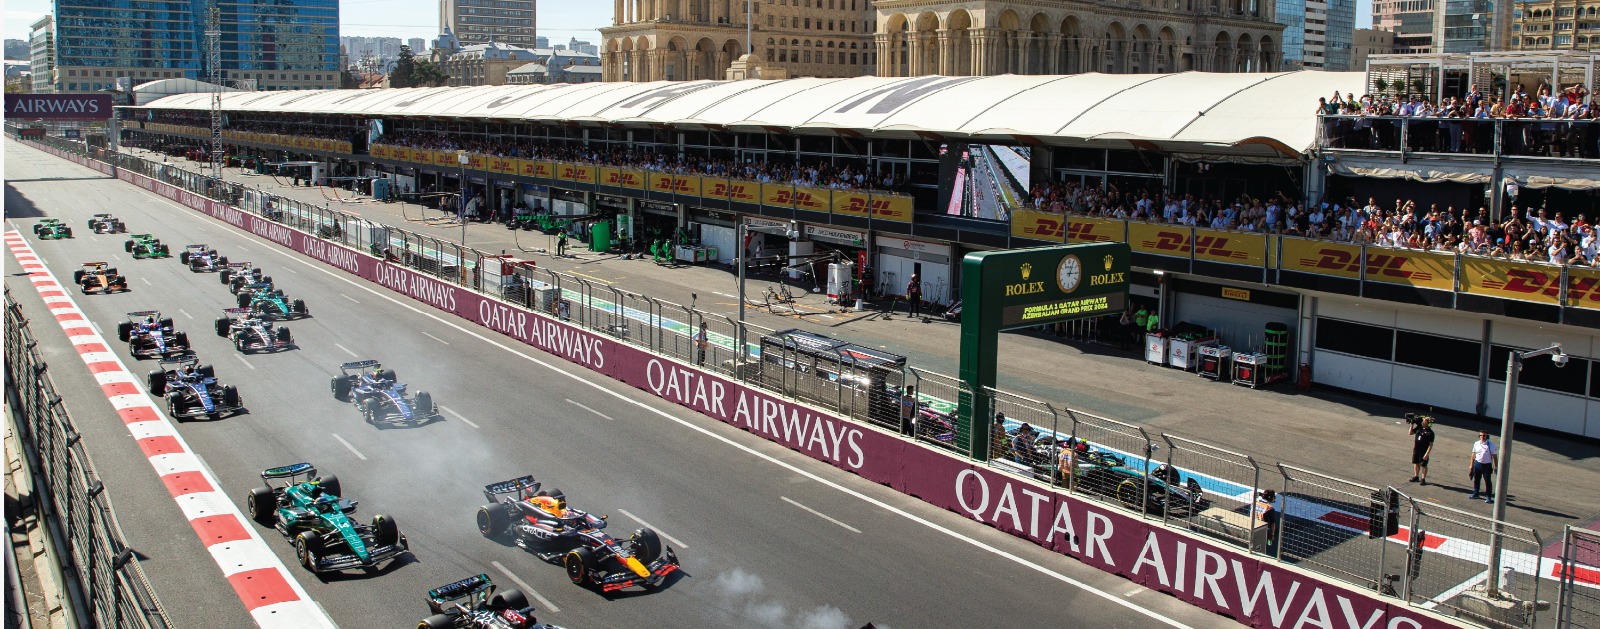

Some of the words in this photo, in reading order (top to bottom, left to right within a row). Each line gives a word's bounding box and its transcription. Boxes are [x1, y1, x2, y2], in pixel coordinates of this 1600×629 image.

[14, 99, 98, 112] AIRWAYS
[565, 168, 586, 178] DHL
[609, 173, 634, 184] DHL
[660, 178, 689, 191] DHL
[714, 184, 747, 199] DHL
[776, 190, 814, 207] DHL
[850, 197, 893, 215] DHL
[212, 203, 225, 220] QATAR
[225, 208, 243, 226] AIRWAYS
[251, 217, 268, 237] QATAR
[268, 223, 292, 246] AIRWAYS
[1035, 218, 1098, 240] DHL
[1155, 231, 1231, 257] DHL
[303, 236, 326, 260] QATAR
[327, 245, 359, 273] AIRWAYS
[1316, 249, 1413, 279] DHL
[376, 262, 407, 293] QATAR
[409, 274, 456, 311] AIRWAYS
[1090, 272, 1125, 286] ROLEX
[1005, 281, 1045, 297] ROLEX
[1024, 304, 1054, 313] FORMULA
[1059, 301, 1080, 309] QATAR
[1080, 297, 1107, 306] AIRWAYS
[1060, 307, 1080, 315] GRAND
[1080, 304, 1094, 312] PRIX
[479, 299, 527, 340] QATAR
[531, 317, 604, 369] AIRWAYS
[646, 358, 727, 418] QATAR
[733, 390, 864, 469] AIRWAYS
[523, 525, 552, 540] ORACLE
[955, 468, 1116, 567] QATAR
[1131, 531, 1422, 629] AIRWAY
[437, 577, 479, 593] PETRONAS
